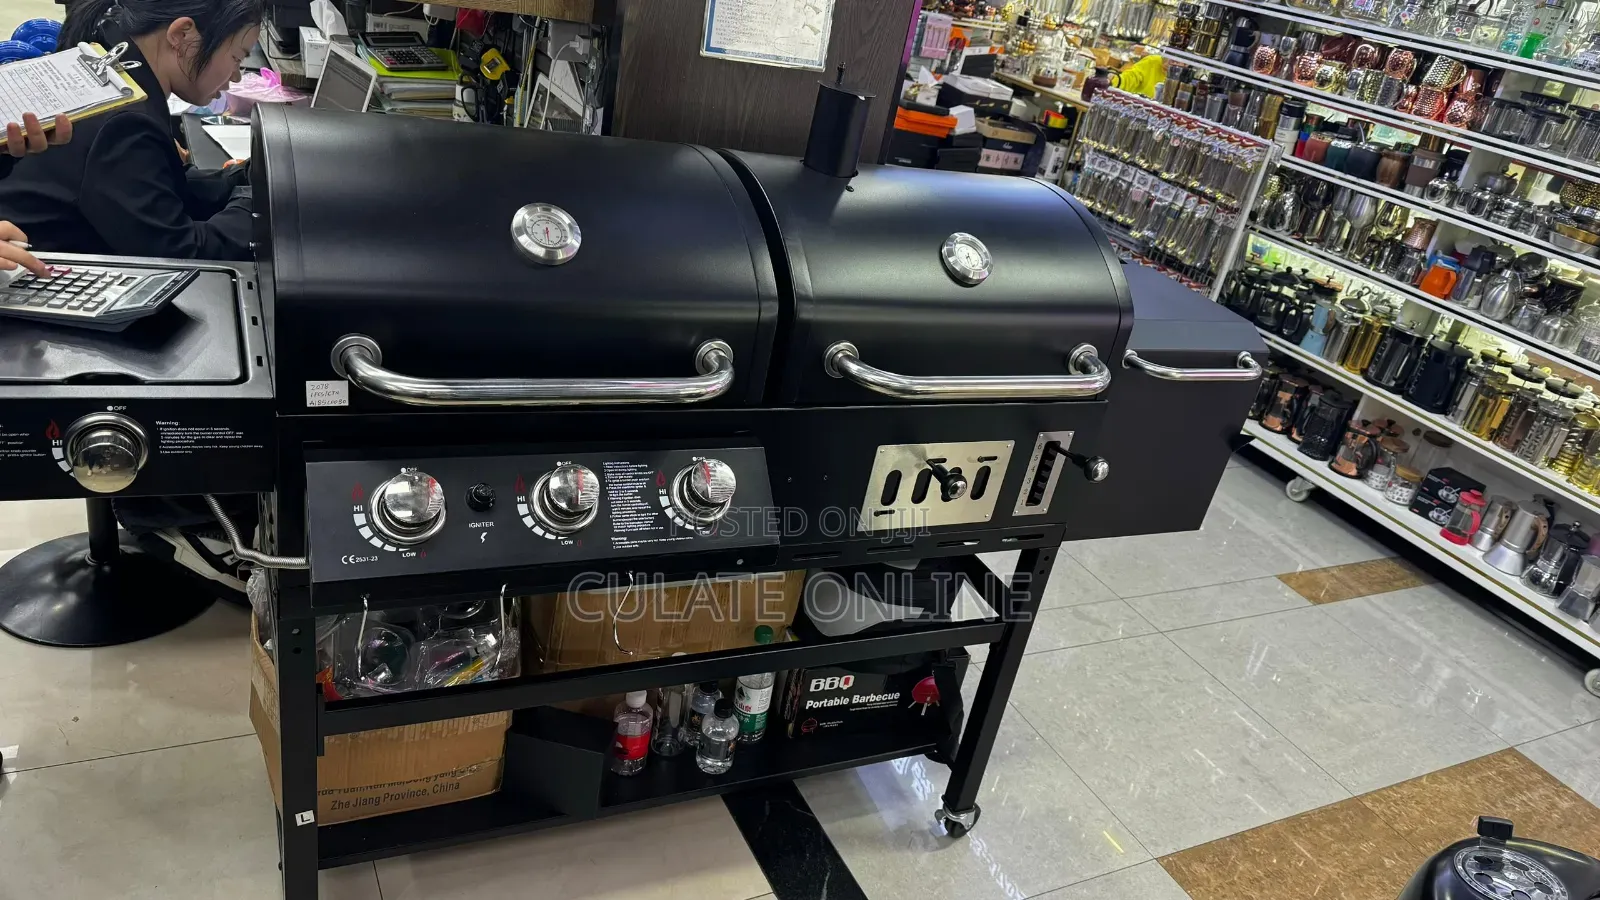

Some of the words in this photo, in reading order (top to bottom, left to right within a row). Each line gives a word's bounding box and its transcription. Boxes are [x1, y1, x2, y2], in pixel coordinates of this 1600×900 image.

[516, 495, 526, 503] HI
[353, 504, 363, 512] HI
[809, 674, 855, 692] BBQ
[805, 696, 850, 710] Portable
[851, 691, 901, 704] Barbecue
[330, 800, 350, 810] Zhe
[352, 795, 381, 808] Jiang
[382, 787, 430, 803] Province,
[432, 780, 461, 795] China
[300, 813, 311, 823] L
